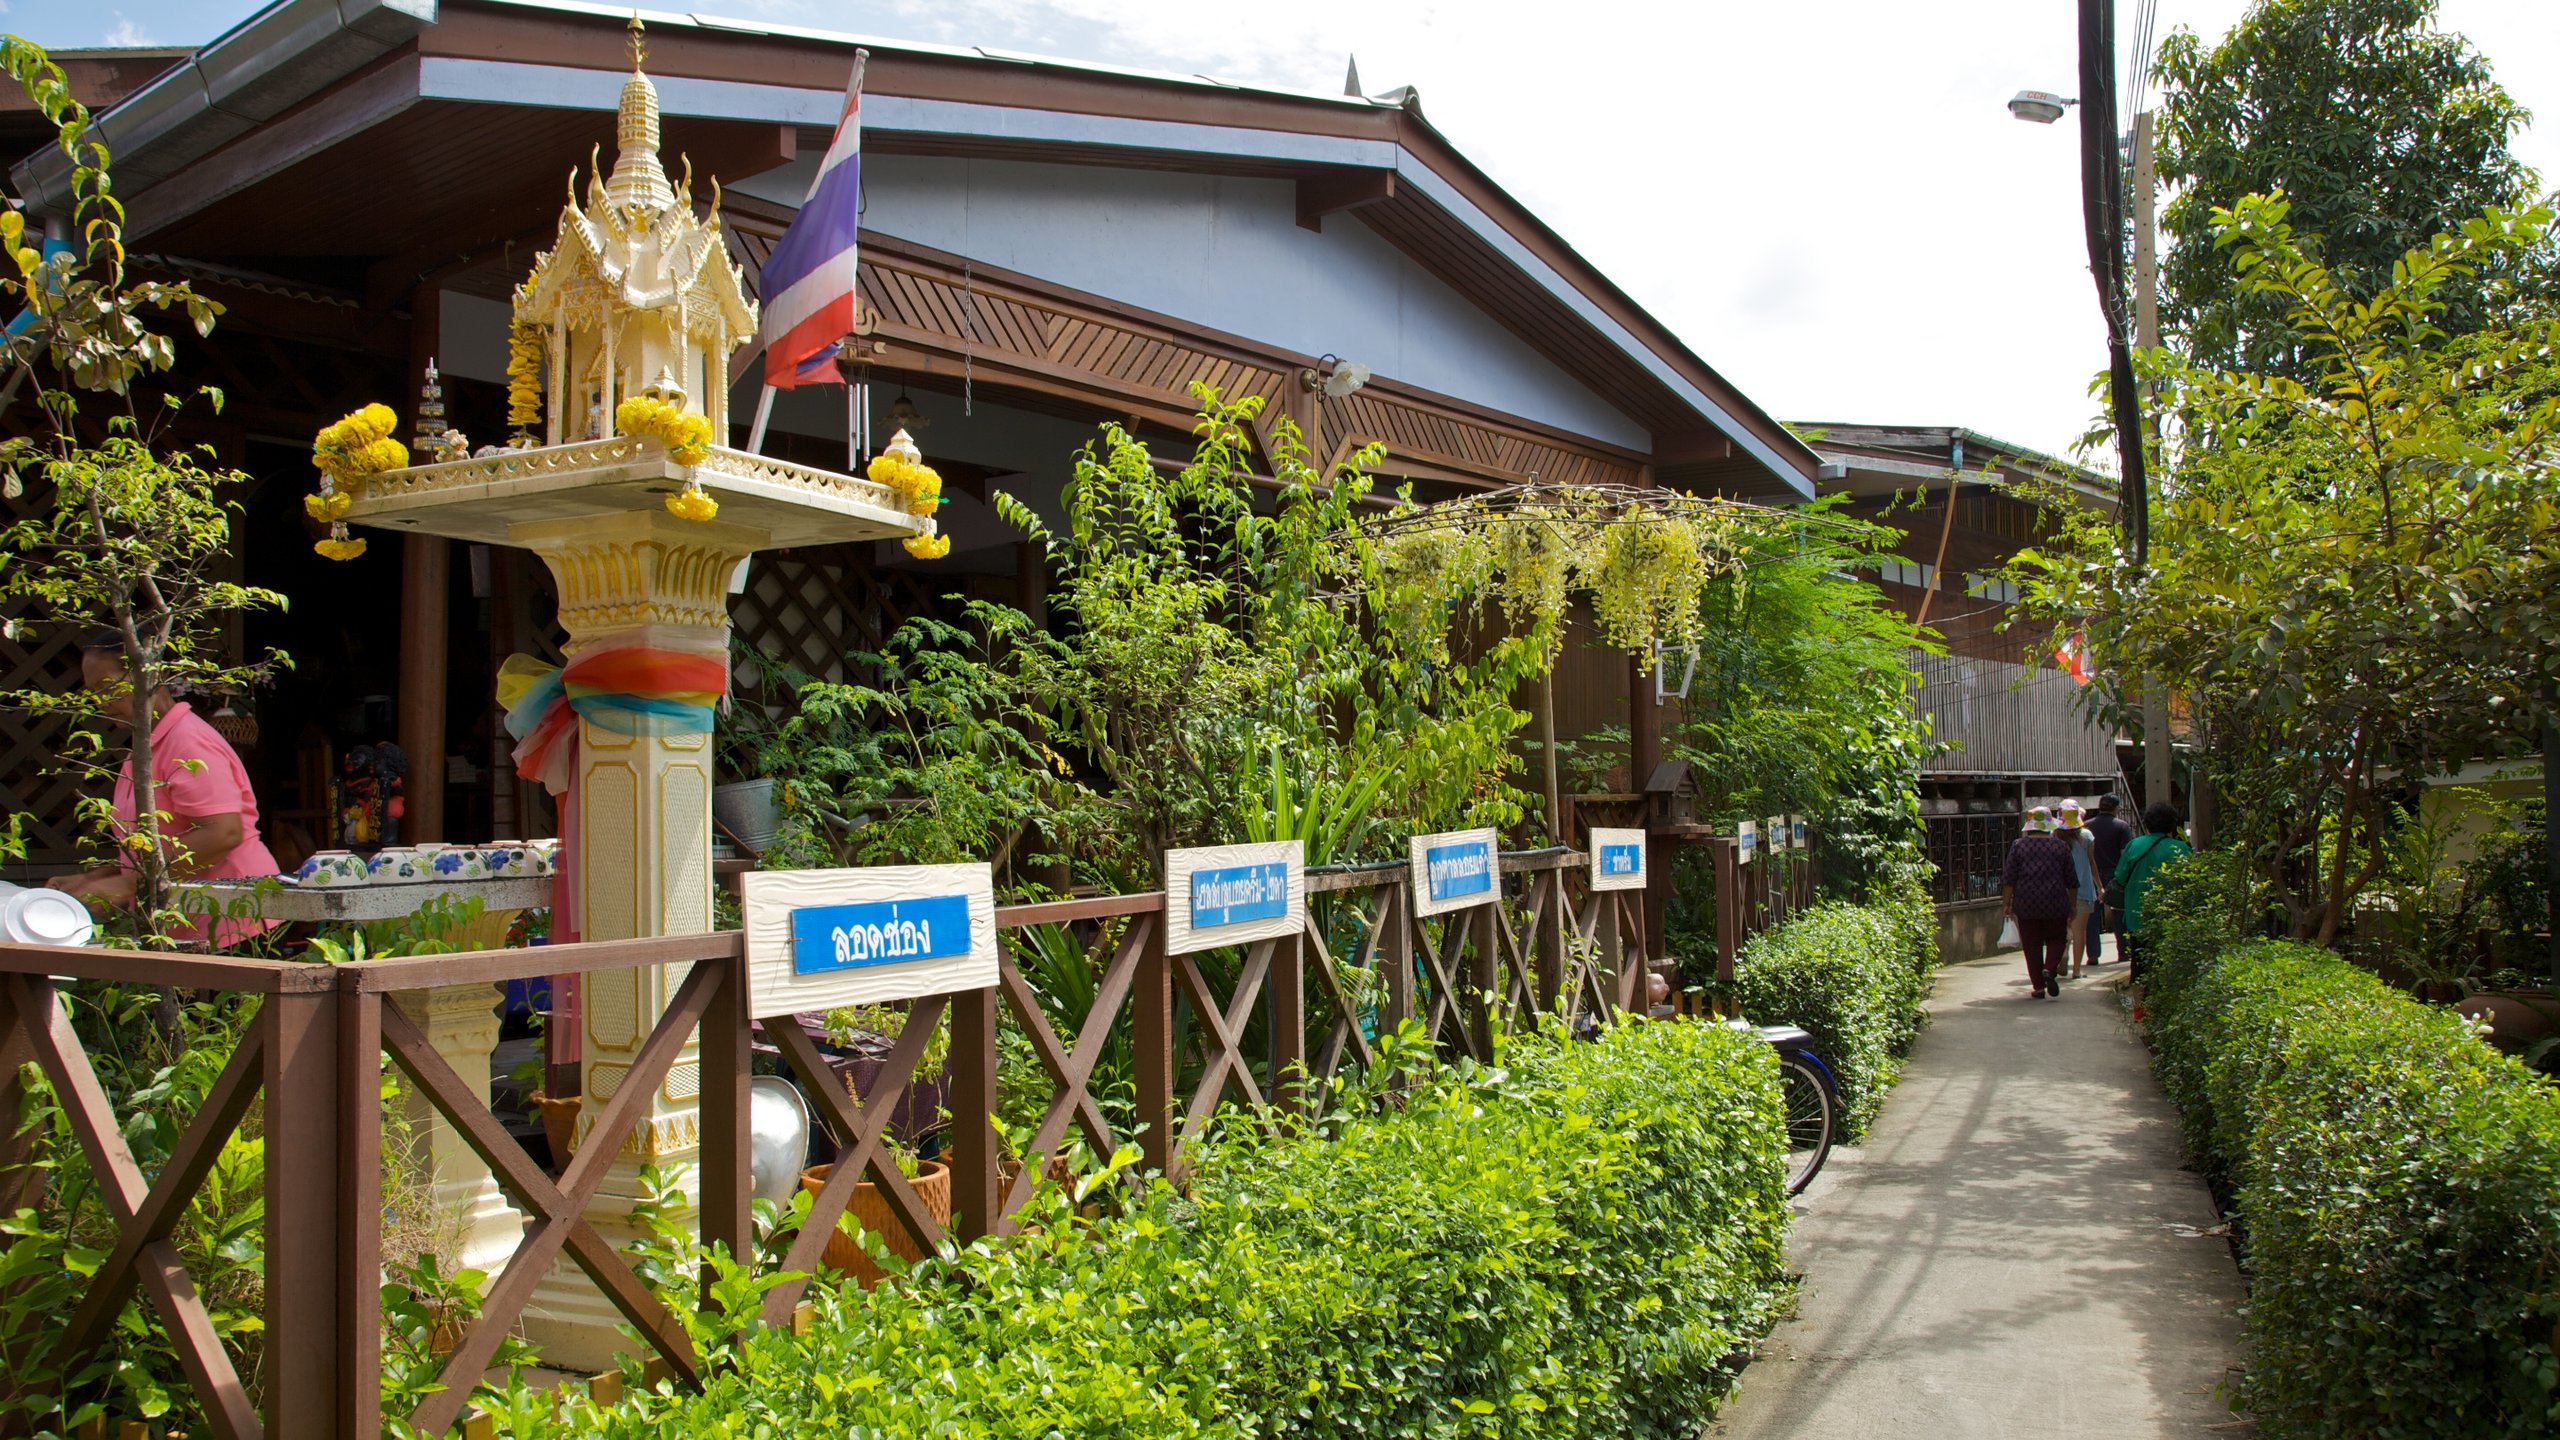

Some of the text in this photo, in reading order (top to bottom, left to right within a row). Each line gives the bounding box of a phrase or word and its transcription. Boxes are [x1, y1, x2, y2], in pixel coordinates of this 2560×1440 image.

[1429, 846, 1490, 896] ลูกตาลลอยแก้ว
[831, 904, 931, 963] ลอดช่อง
